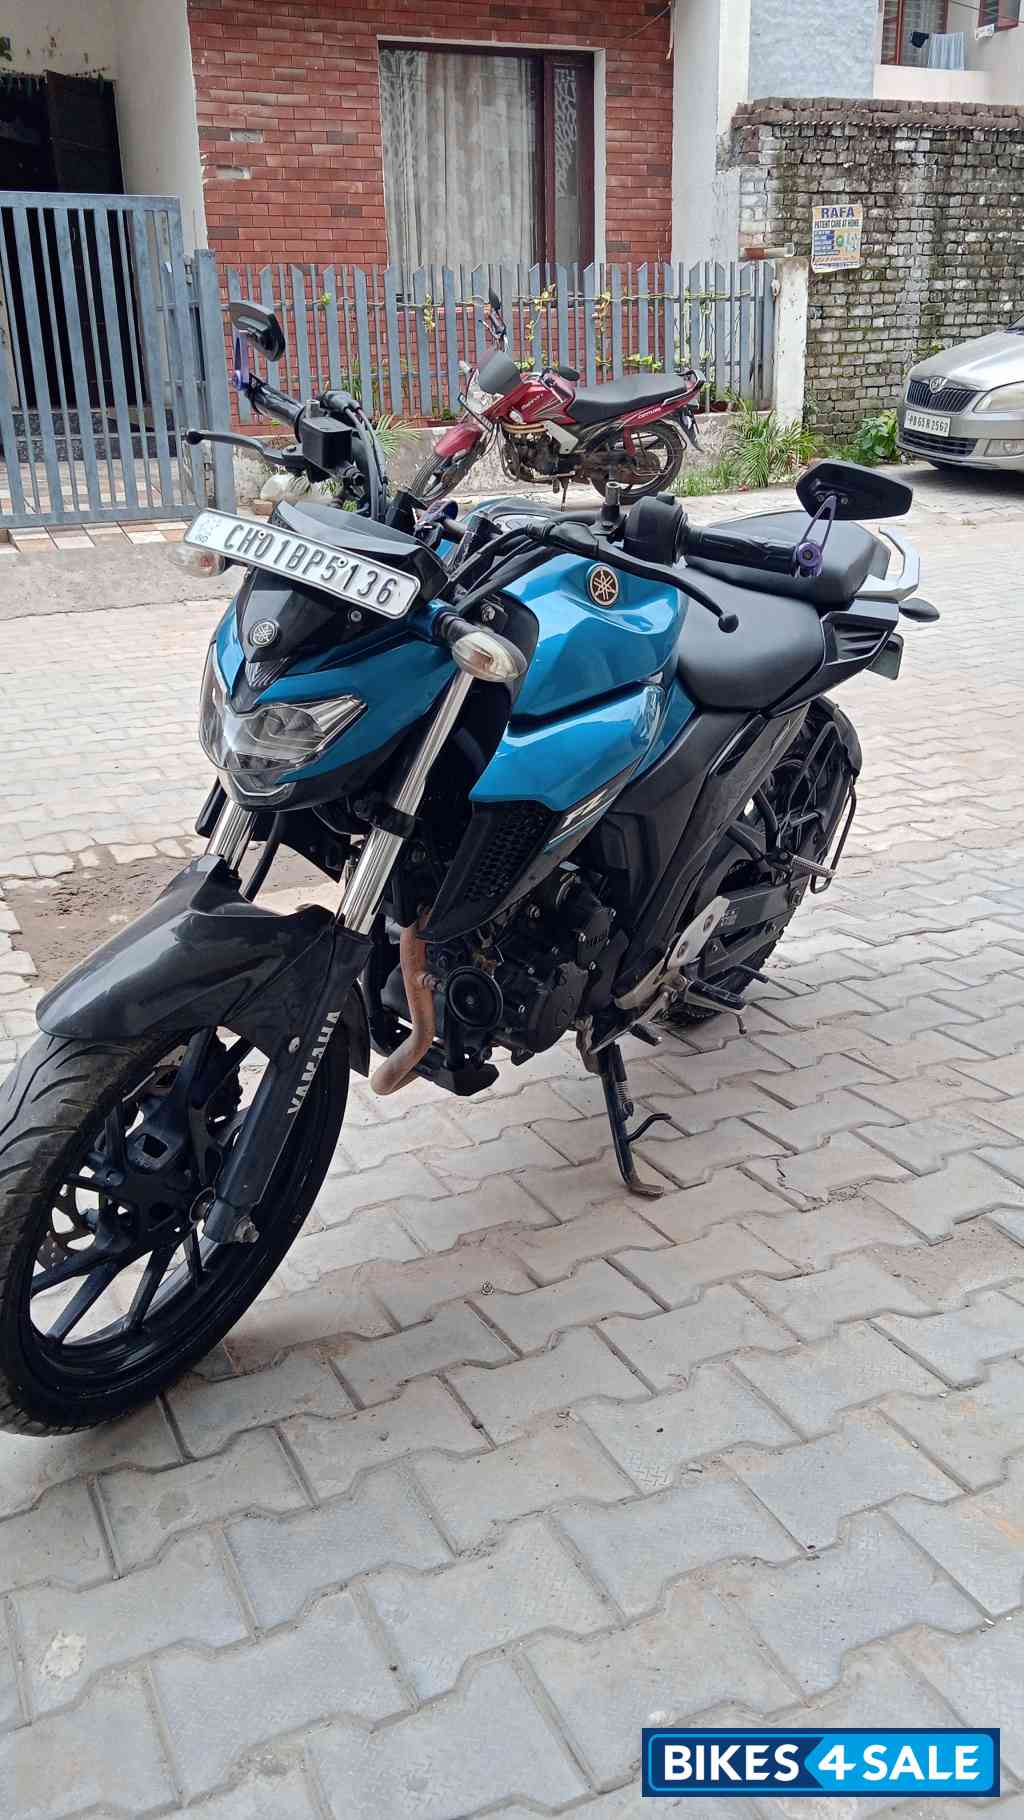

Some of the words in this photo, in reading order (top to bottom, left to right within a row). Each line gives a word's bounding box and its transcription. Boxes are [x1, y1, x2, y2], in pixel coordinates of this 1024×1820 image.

[821, 207, 855, 219] RAFA
[223, 523, 398, 605] CH01BP5136
[287, 1010, 342, 1114] YAMAHA
